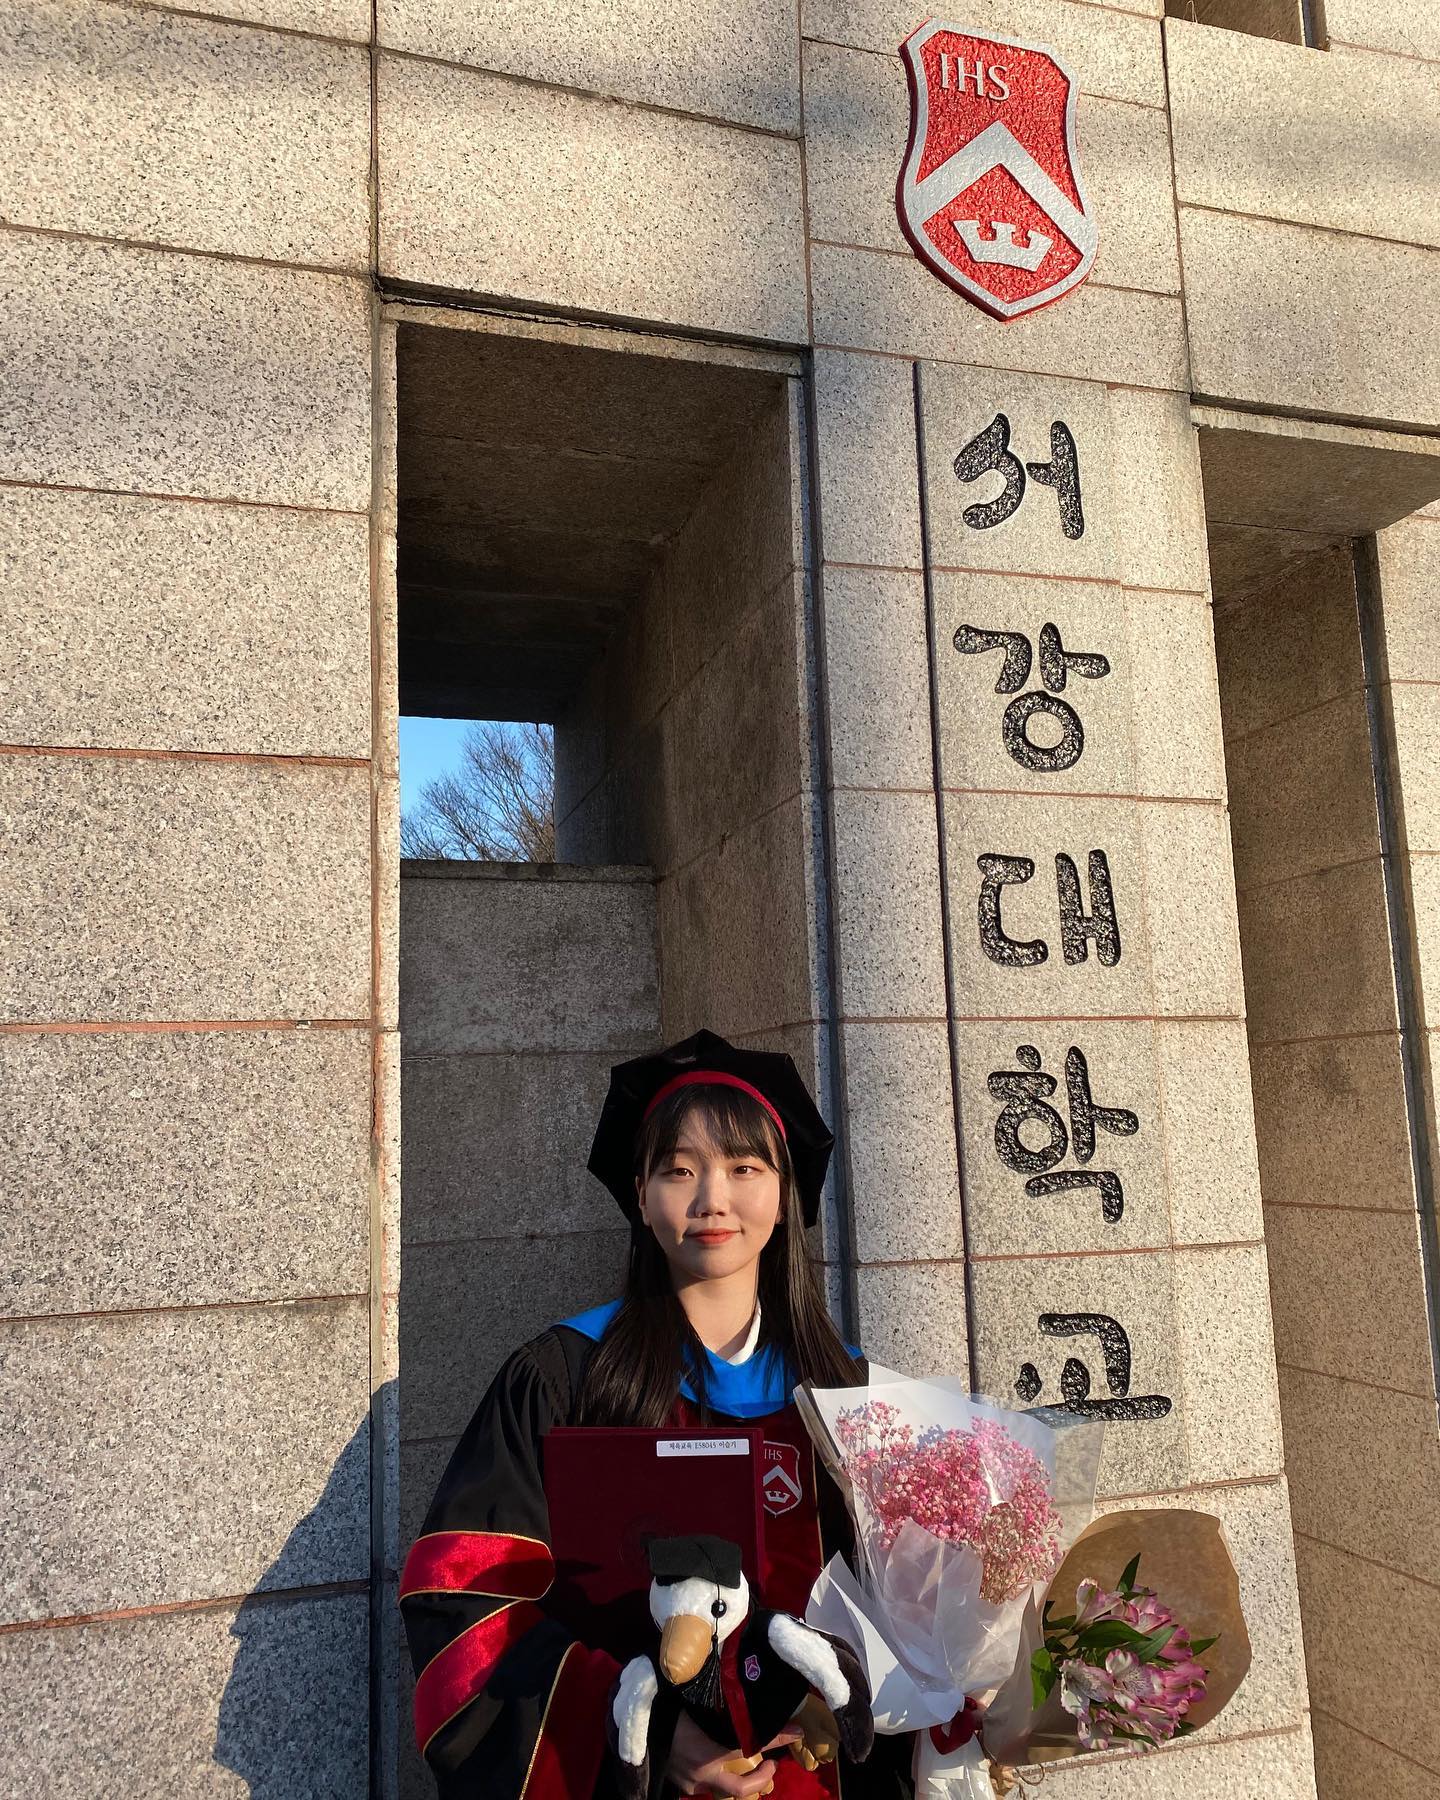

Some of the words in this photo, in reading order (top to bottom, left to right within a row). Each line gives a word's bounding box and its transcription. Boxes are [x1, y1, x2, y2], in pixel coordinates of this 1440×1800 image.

[940, 52, 1011, 102] IHS
[952, 412, 1173, 1422] 서강대학교
[764, 1448, 783, 1461] IHS
